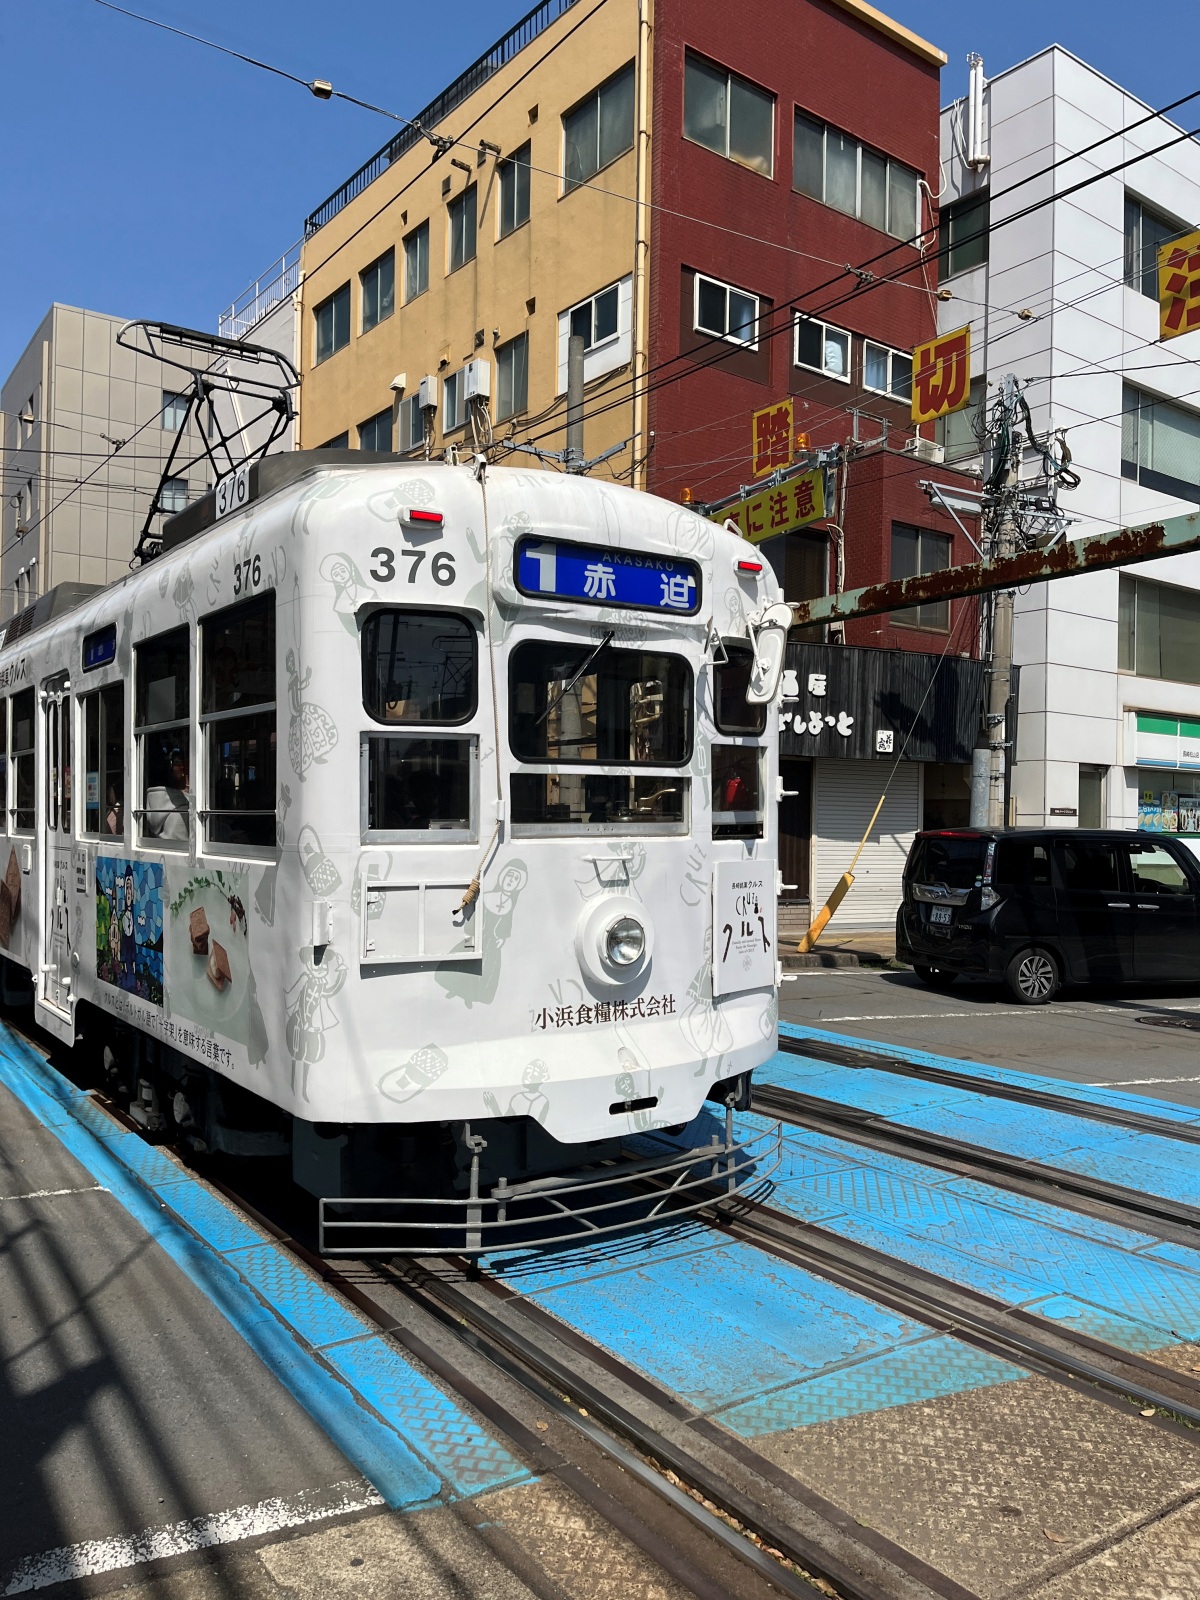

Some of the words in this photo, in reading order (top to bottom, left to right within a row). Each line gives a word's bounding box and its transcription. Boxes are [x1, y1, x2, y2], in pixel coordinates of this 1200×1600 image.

[915, 334, 967, 416] 切
[756, 405, 791, 474] 踏
[218, 469, 246, 515] 376
[233, 553, 262, 596] 376
[370, 547, 457, 586] 376
[525, 541, 557, 593] 1
[602, 552, 675, 572] AKASAKO
[583, 563, 690, 608] 赤迫
[534, 993, 677, 1030] 小浜食糧株式会社
